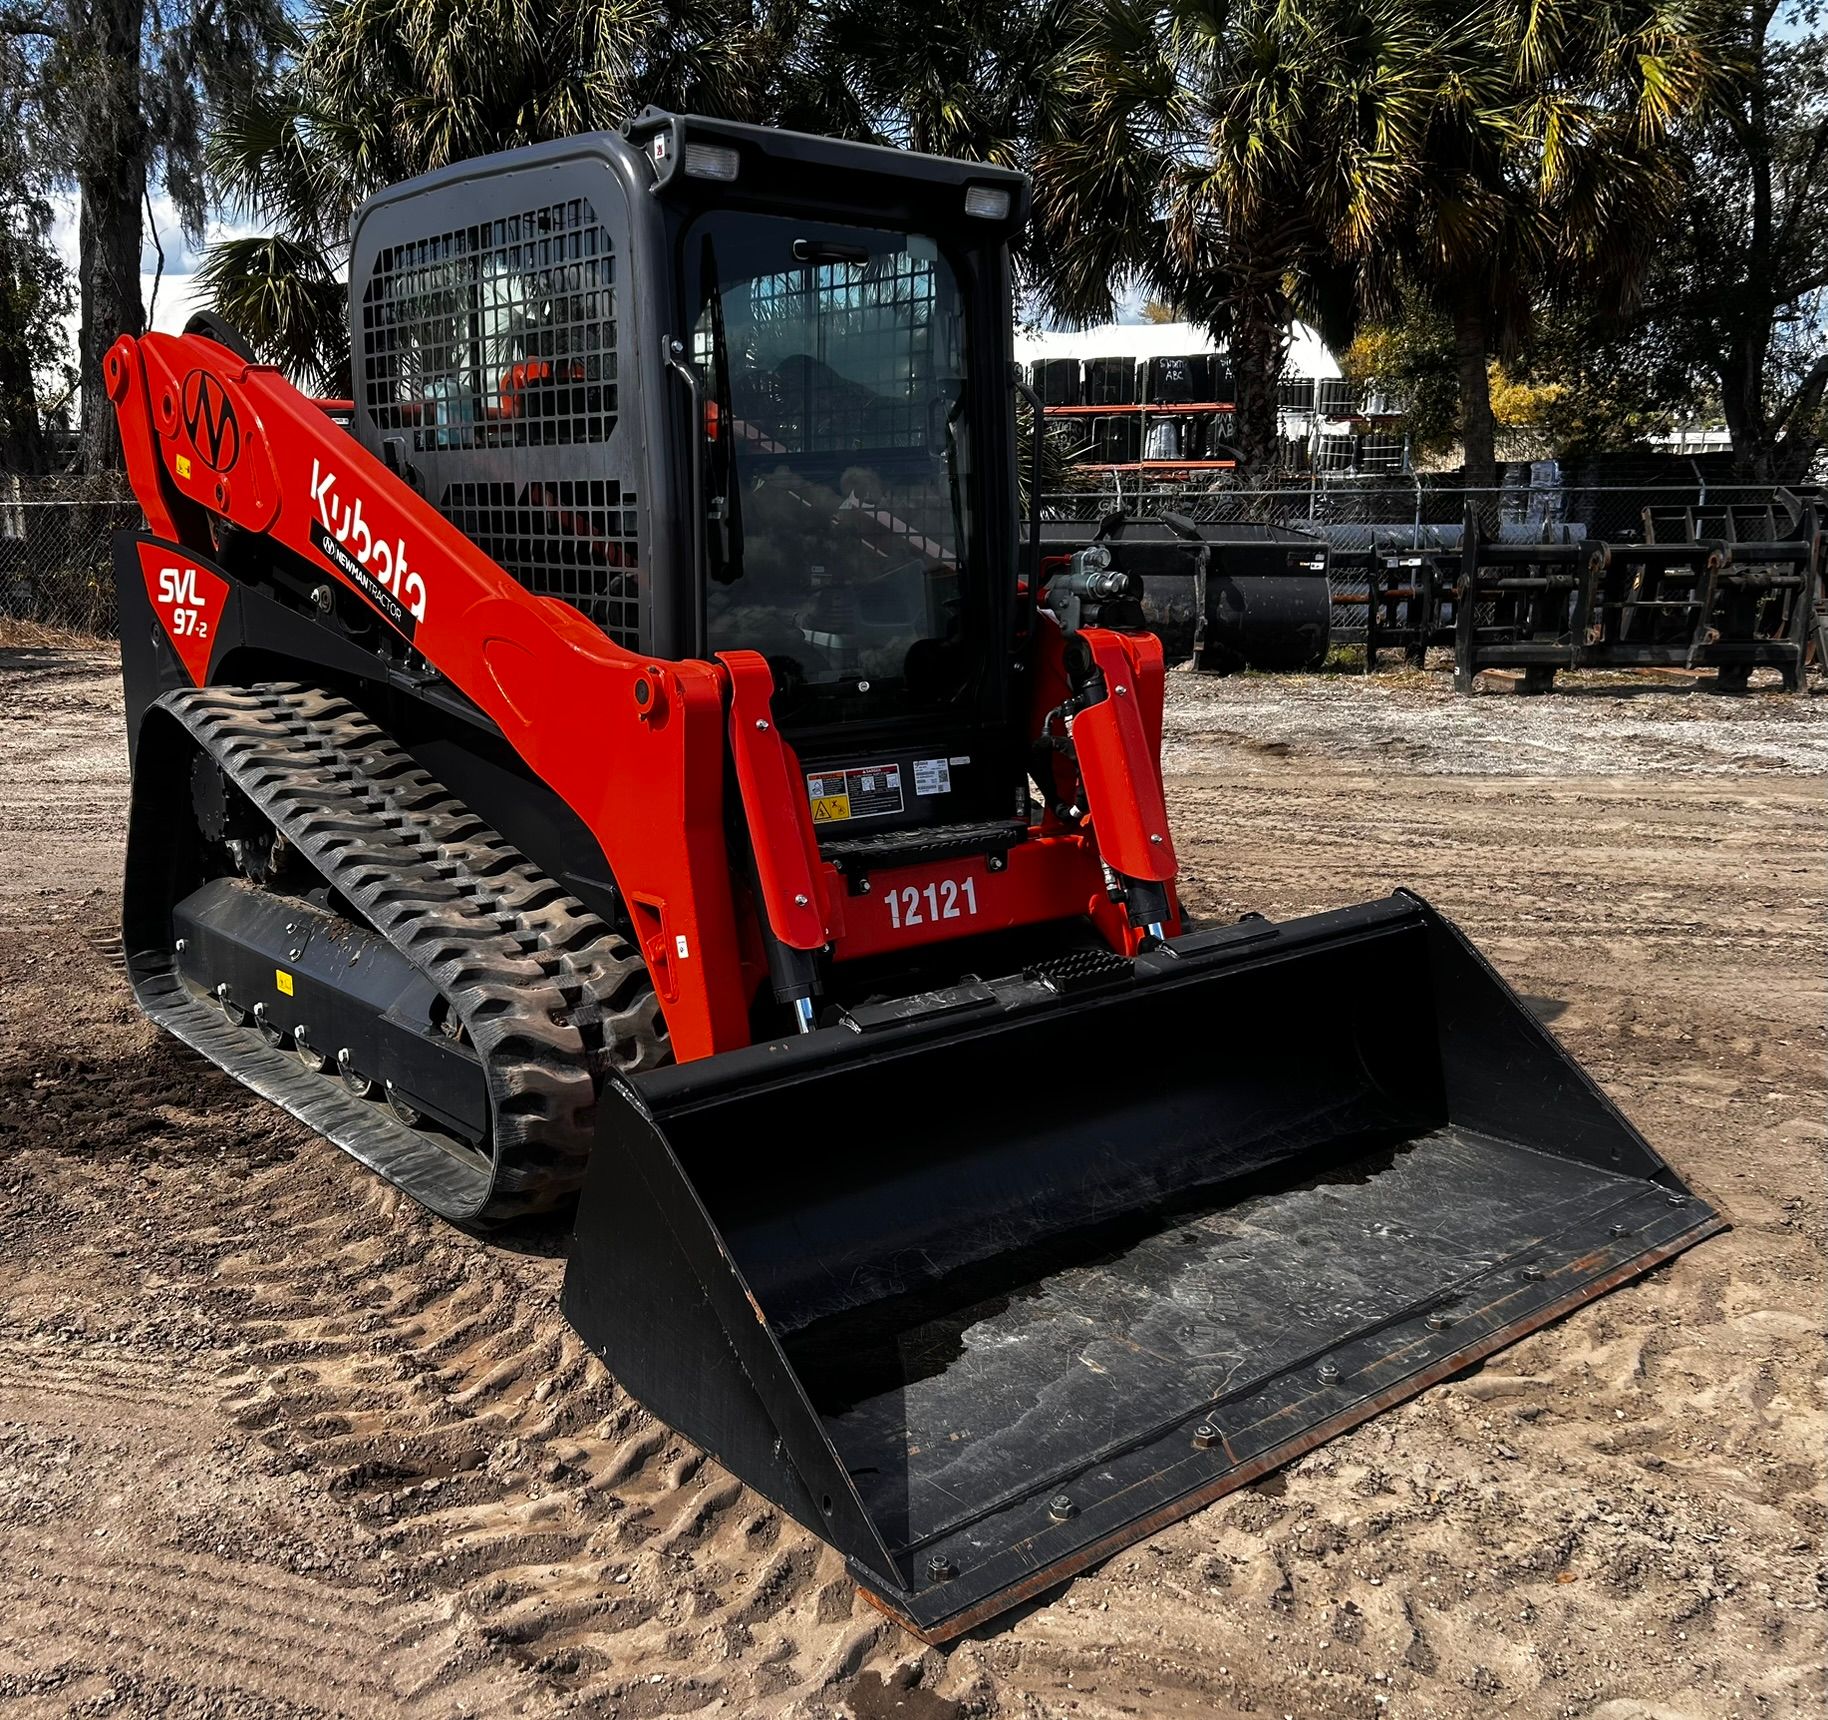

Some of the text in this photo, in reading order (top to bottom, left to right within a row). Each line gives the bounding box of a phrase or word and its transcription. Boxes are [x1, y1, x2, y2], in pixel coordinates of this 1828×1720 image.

[1165, 370, 1184, 381] ABC
[310, 457, 427, 623] Kubota
[157, 568, 206, 606] SVL
[173, 607, 208, 638] 97-2
[884, 876, 977, 929] 12121
